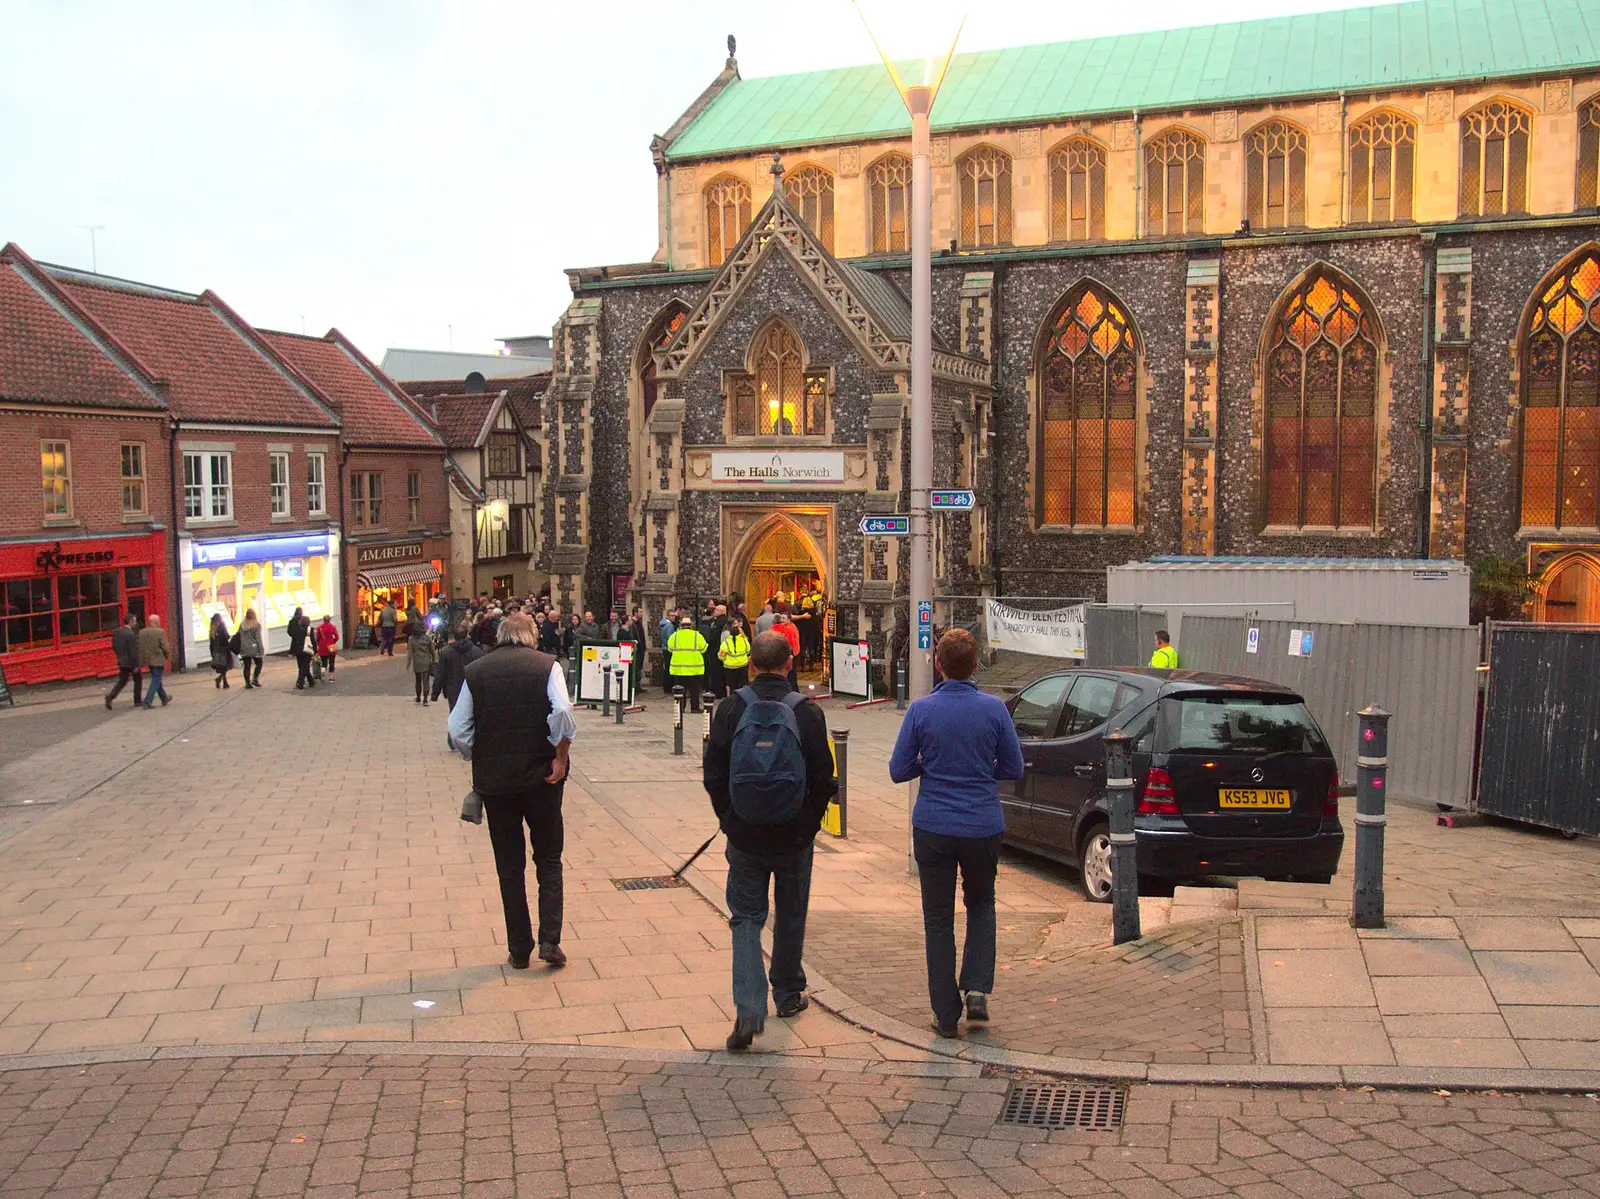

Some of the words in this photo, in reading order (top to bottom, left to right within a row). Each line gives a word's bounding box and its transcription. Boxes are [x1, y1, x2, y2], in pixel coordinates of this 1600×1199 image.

[724, 466, 745, 477] The
[749, 466, 779, 477] Halls
[783, 466, 830, 477] Norwich
[360, 544, 421, 561] AMARETTO
[1224, 790, 1258, 804] KS53
[1261, 791, 1285, 804] JVG
